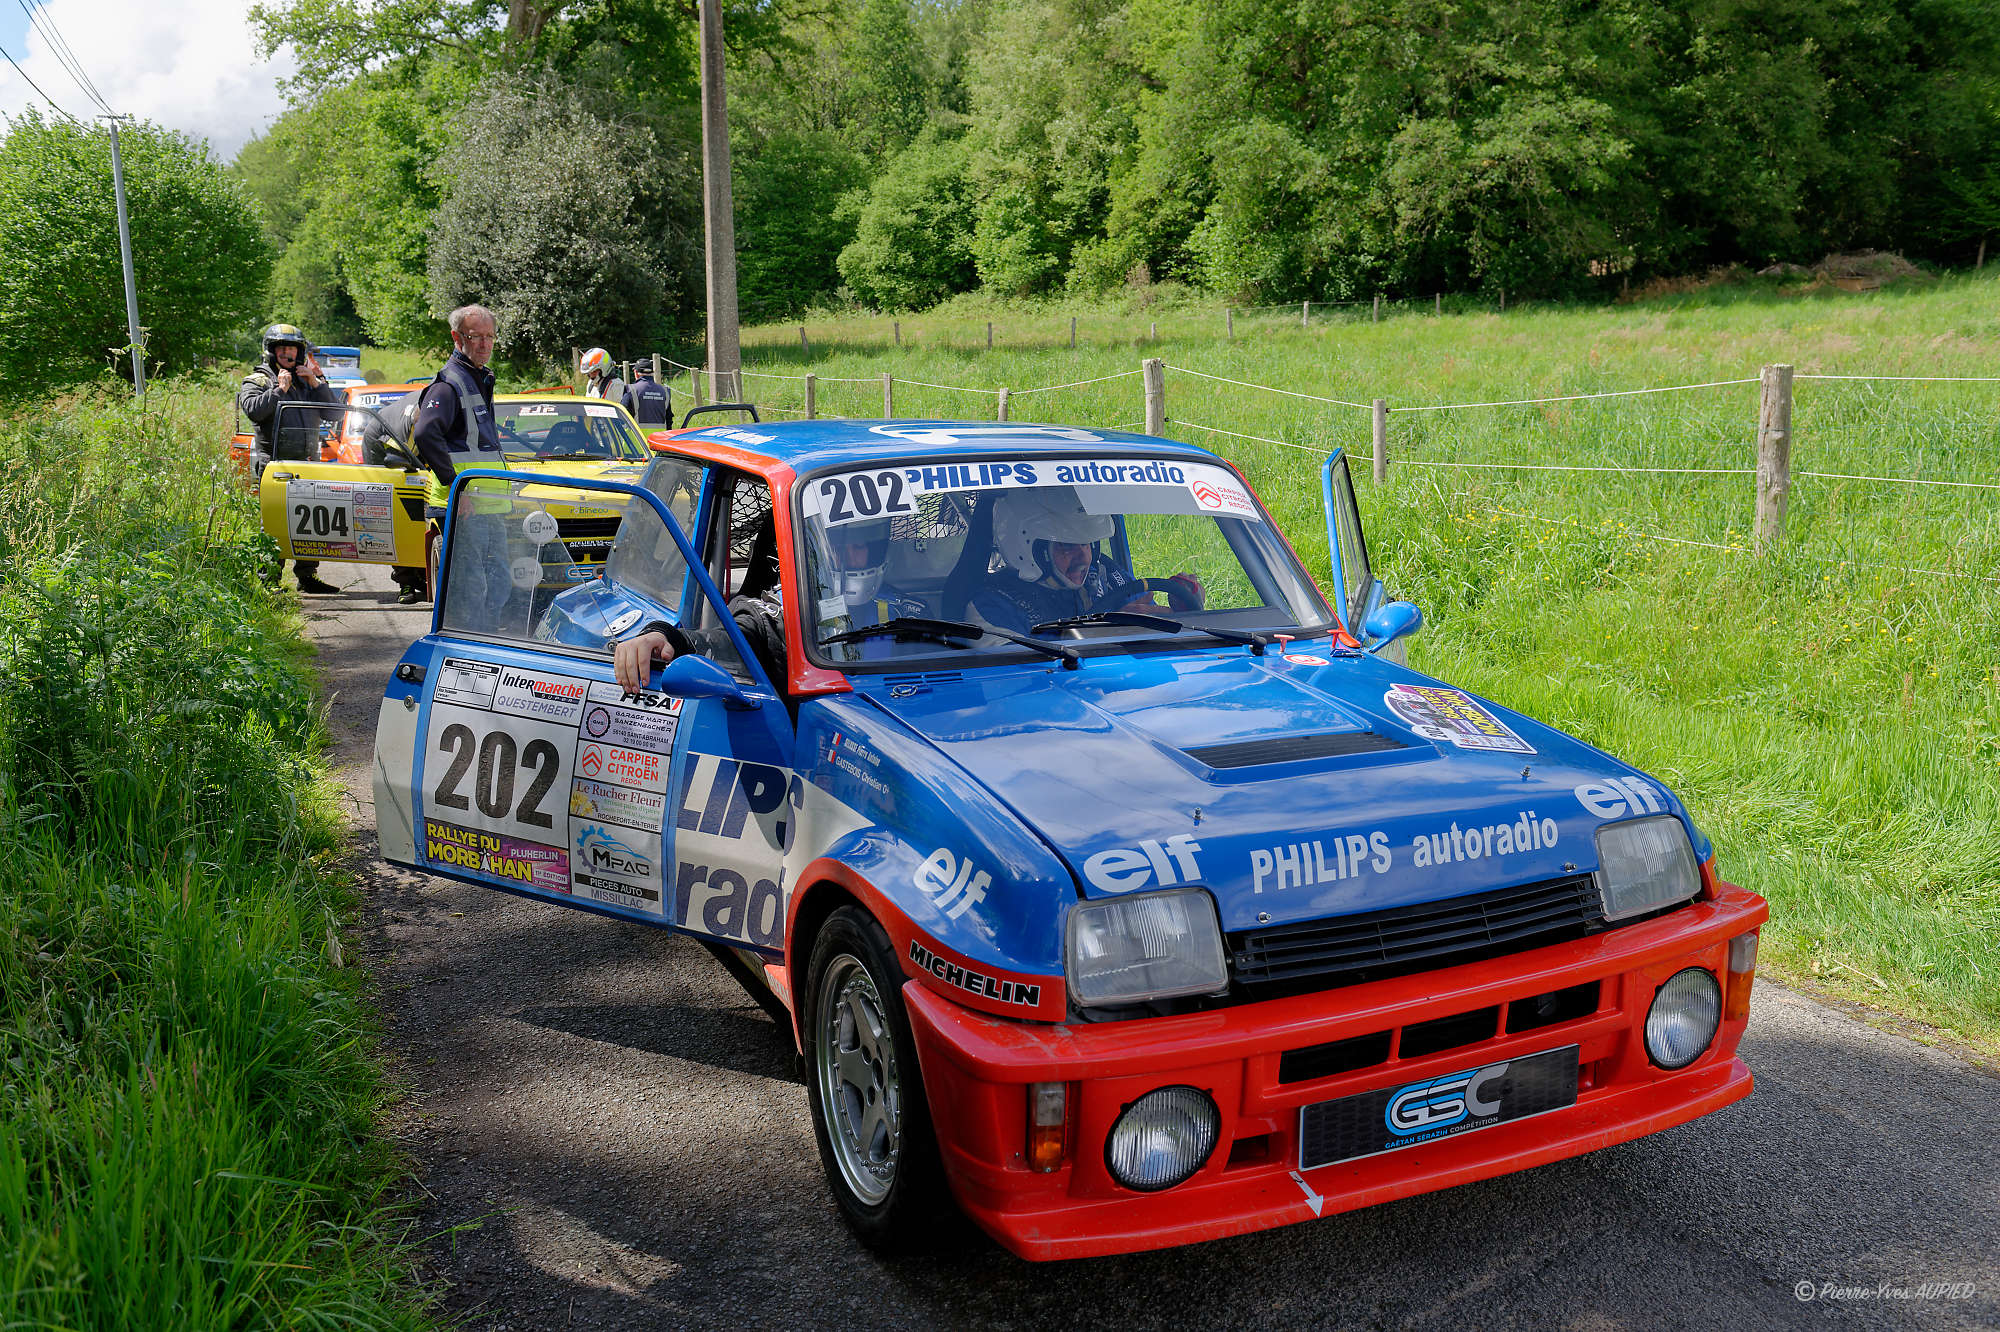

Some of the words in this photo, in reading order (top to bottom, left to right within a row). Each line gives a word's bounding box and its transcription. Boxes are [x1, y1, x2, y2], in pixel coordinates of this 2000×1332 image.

[905, 462, 1037, 491] PHILIPS
[1056, 460, 1186, 484] autoradio
[820, 471, 911, 523] 202
[294, 504, 349, 537] 204
[502, 672, 584, 698] Intermarché
[497, 695, 577, 718] QUESTEMBERT
[620, 690, 671, 710] FFSA
[615, 711, 645, 721] GARAGE
[645, 717, 674, 727] MARTIN
[607, 763, 659, 782] CITROËN
[609, 749, 659, 768] CARPIER
[435, 723, 560, 829] 202
[620, 778, 642, 786] REDON
[576, 781, 590, 794] Le
[591, 783, 628, 801] Rucher
[629, 791, 662, 808] Fleuri
[1574, 776, 1666, 819] elf
[426, 822, 478, 847] RALLYE
[480, 835, 501, 852] DU
[510, 848, 559, 860] PLUHERLIN
[590, 847, 651, 877] MPAC
[1083, 833, 1203, 893] elf
[1250, 831, 1392, 893] PHILIPS
[1413, 810, 1559, 868] autoradio
[589, 877, 619, 893] PIECES
[619, 883, 643, 897] AUTO
[913, 848, 992, 920] elf
[591, 889, 644, 909] MISSILLAC
[909, 939, 1040, 1007] MICHELIN
[1385, 1062, 1510, 1136] GSC
[1449, 1116, 1499, 1133] COMPÉTITION
